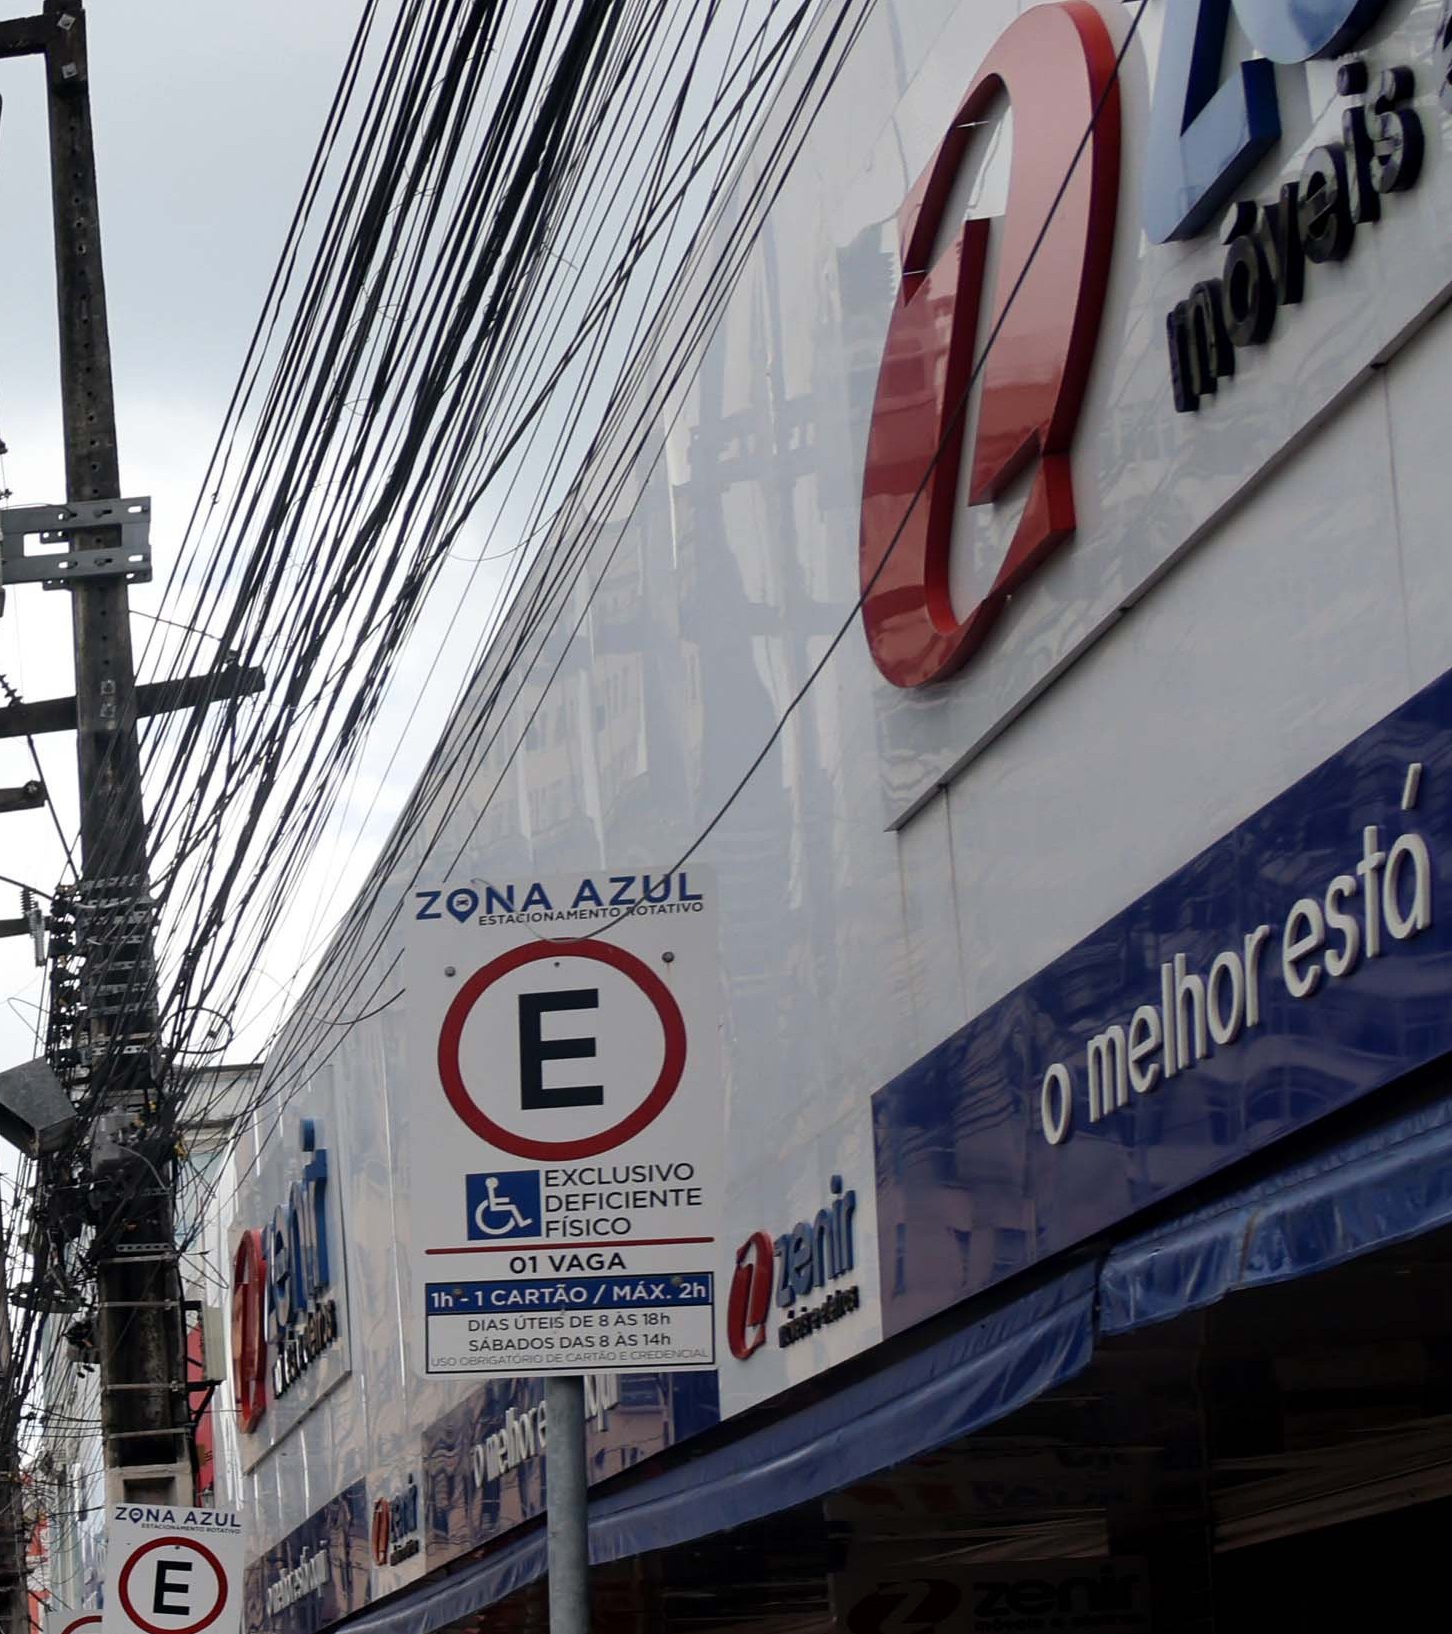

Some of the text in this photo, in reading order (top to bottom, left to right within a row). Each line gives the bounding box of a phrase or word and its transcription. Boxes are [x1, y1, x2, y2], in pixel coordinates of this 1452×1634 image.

[416, 873, 703, 923] ZONA AZUL
[478, 901, 704, 926] ESTACIONAMENTO ROTATIVO
[1043, 763, 1434, 1146] o melhor está
[518, 988, 604, 1111] E
[545, 1163, 694, 1187] EXCLUSIVO
[545, 1188, 703, 1213] DEFICIENTE
[545, 1215, 632, 1238] FÍSICO
[510, 1253, 627, 1274] 01 VAGA
[431, 1291, 453, 1308] 1h
[475, 1291, 483, 1306] 1
[490, 1284, 588, 1306] CARTÃO
[593, 1284, 605, 1305] /
[612, 1281, 672, 1302] MÁX.
[678, 1283, 706, 1299] 2h
[468, 1311, 671, 1332] DIAS ÚTEIS DE 8 ÀS 18h
[469, 1331, 671, 1352] SÁBADOS DAS 8 ÀS 14h
[431, 1348, 709, 1368] USO OBRIGATÓRIO DE CARTÃO E CREDENCIAL
[115, 1506, 242, 1528] ZONA AZUL
[141, 1523, 205, 1533] ESTACIONAMENTO
[153, 1560, 193, 1616] E
